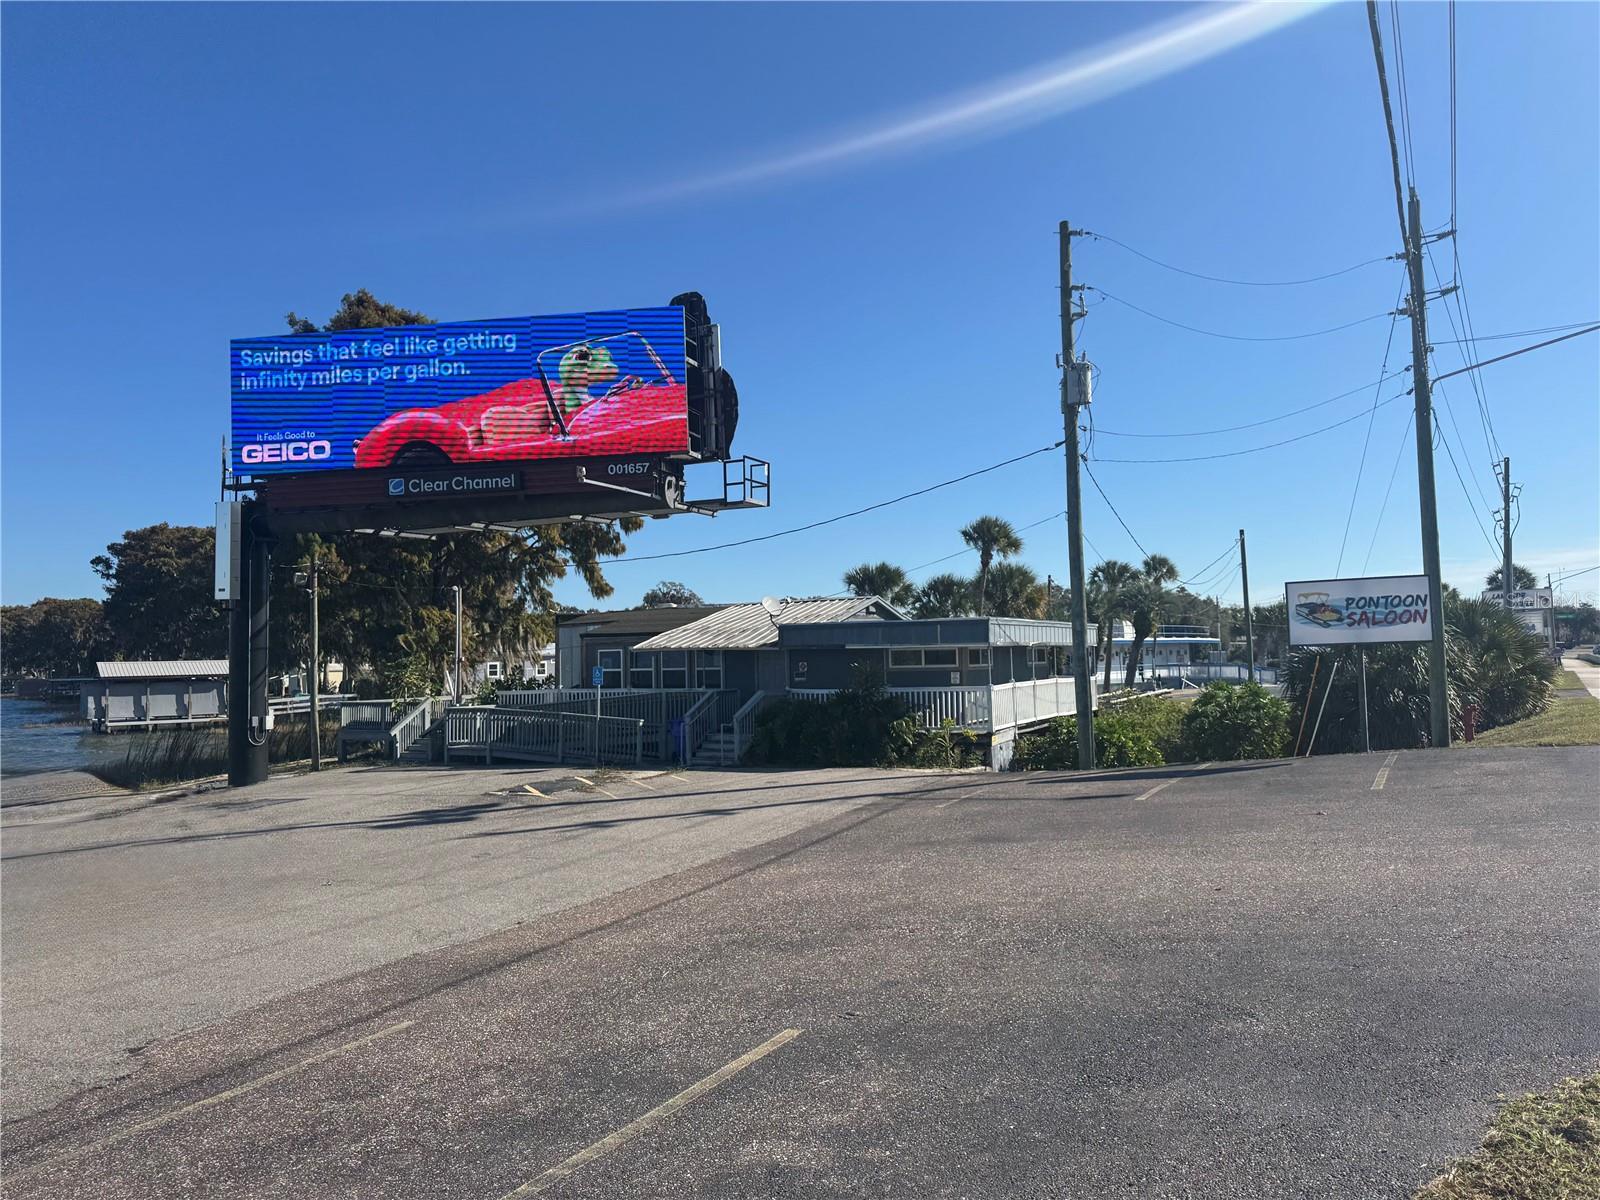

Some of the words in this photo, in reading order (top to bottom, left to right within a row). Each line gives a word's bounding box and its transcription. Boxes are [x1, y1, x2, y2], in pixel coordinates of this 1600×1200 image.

[240, 346, 313, 367] Savings
[317, 342, 358, 361] that
[362, 337, 400, 358] feel
[404, 335, 438, 355] like
[443, 330, 517, 354] getting
[240, 369, 307, 391] infinity
[311, 363, 362, 386] miles
[367, 365, 401, 386] per
[404, 359, 471, 383] gallon.
[264, 432, 284, 441] Feels
[284, 431, 306, 440] Good
[307, 431, 316, 439] to
[241, 440, 331, 464] GEICO
[607, 463, 650, 475] 001657
[408, 478, 449, 493] Clear
[452, 474, 515, 490] Channel
[1345, 594, 1428, 611] PONTOON
[1346, 609, 1428, 628] SALOON
